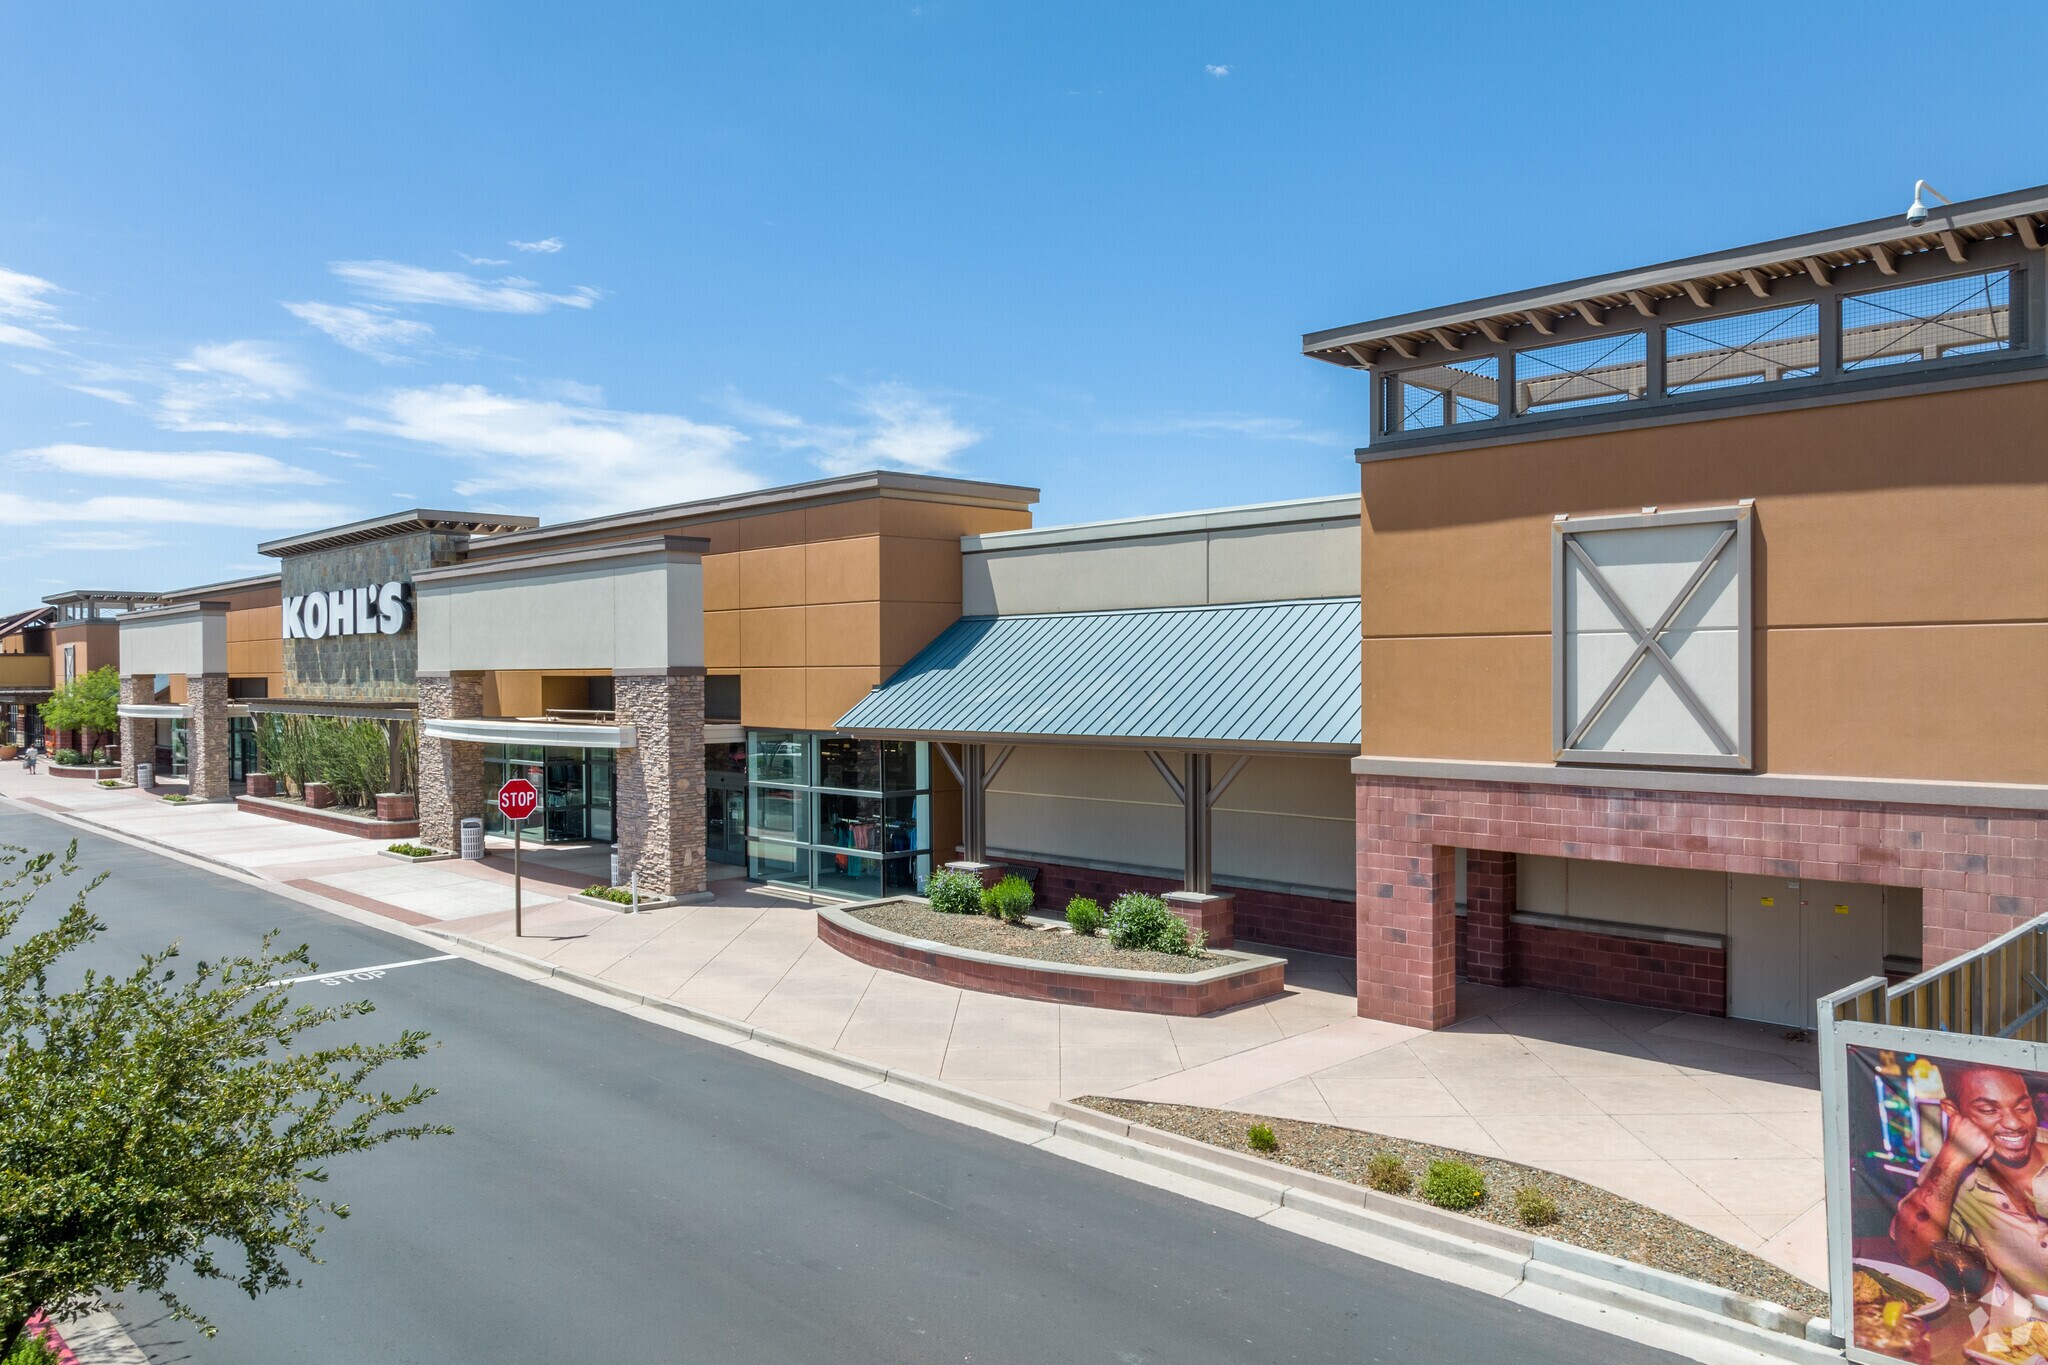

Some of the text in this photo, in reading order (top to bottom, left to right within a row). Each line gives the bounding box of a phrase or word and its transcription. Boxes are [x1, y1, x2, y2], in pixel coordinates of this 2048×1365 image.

[282, 581, 405, 639] KOHL'S
[501, 791, 535, 807] STOP
[319, 970, 386, 986] STOP
